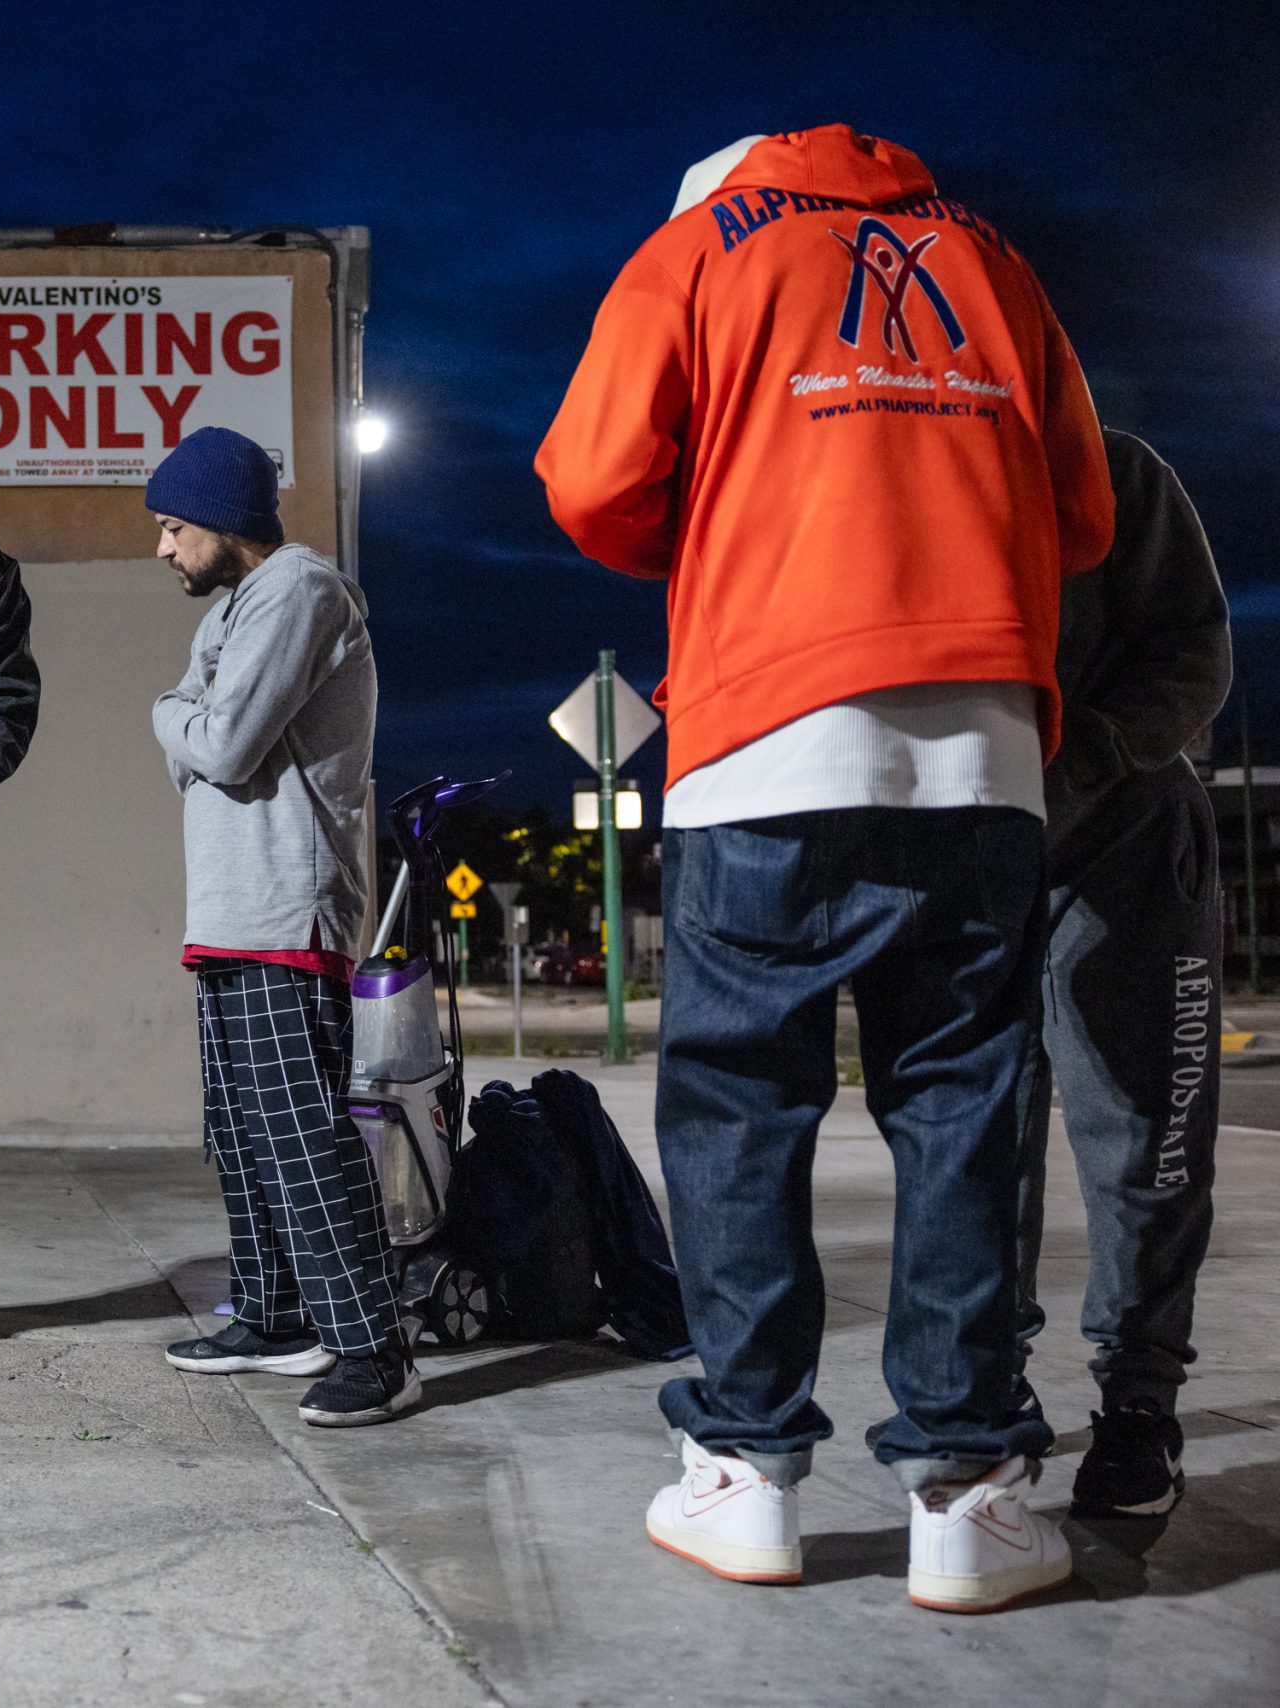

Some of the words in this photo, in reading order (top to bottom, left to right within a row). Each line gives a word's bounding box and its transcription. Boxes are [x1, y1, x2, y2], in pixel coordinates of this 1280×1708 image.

[710, 186, 845, 254] ALPH
[790, 371, 848, 396] Where
[856, 365, 936, 390] Miracles
[14, 468, 49, 476] TOWED
[97, 468, 142, 476] OWNER'S
[16, 459, 94, 467] UNAUTHORISED
